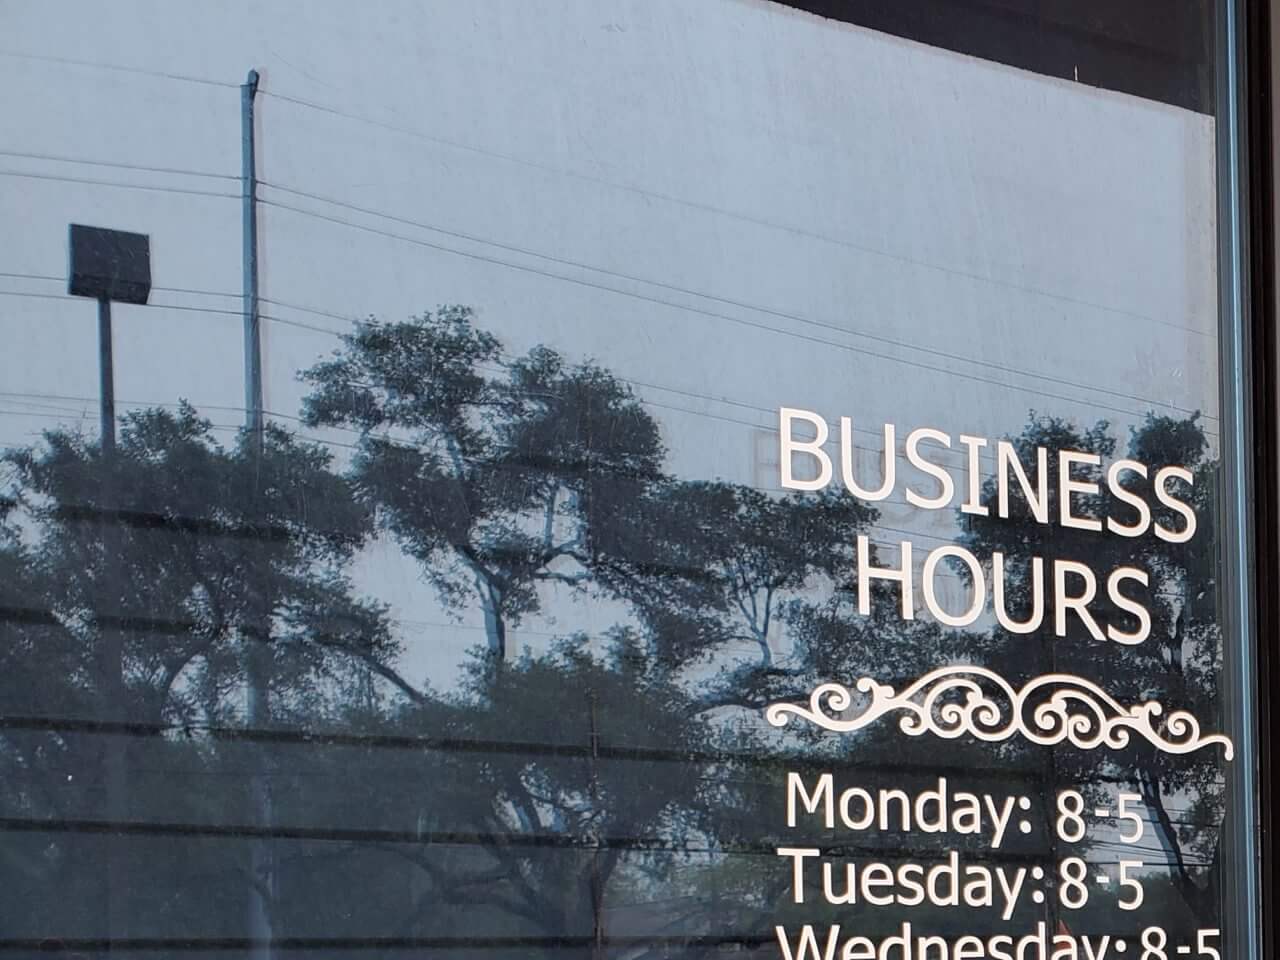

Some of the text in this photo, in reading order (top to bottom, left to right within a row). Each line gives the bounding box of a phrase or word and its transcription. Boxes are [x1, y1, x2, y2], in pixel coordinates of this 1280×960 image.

[780, 407, 1198, 544] BUSINESS
[857, 535, 1152, 646] HOURS
[785, 771, 1032, 848] Monday:
[776, 848, 1045, 920] Tuesday:
